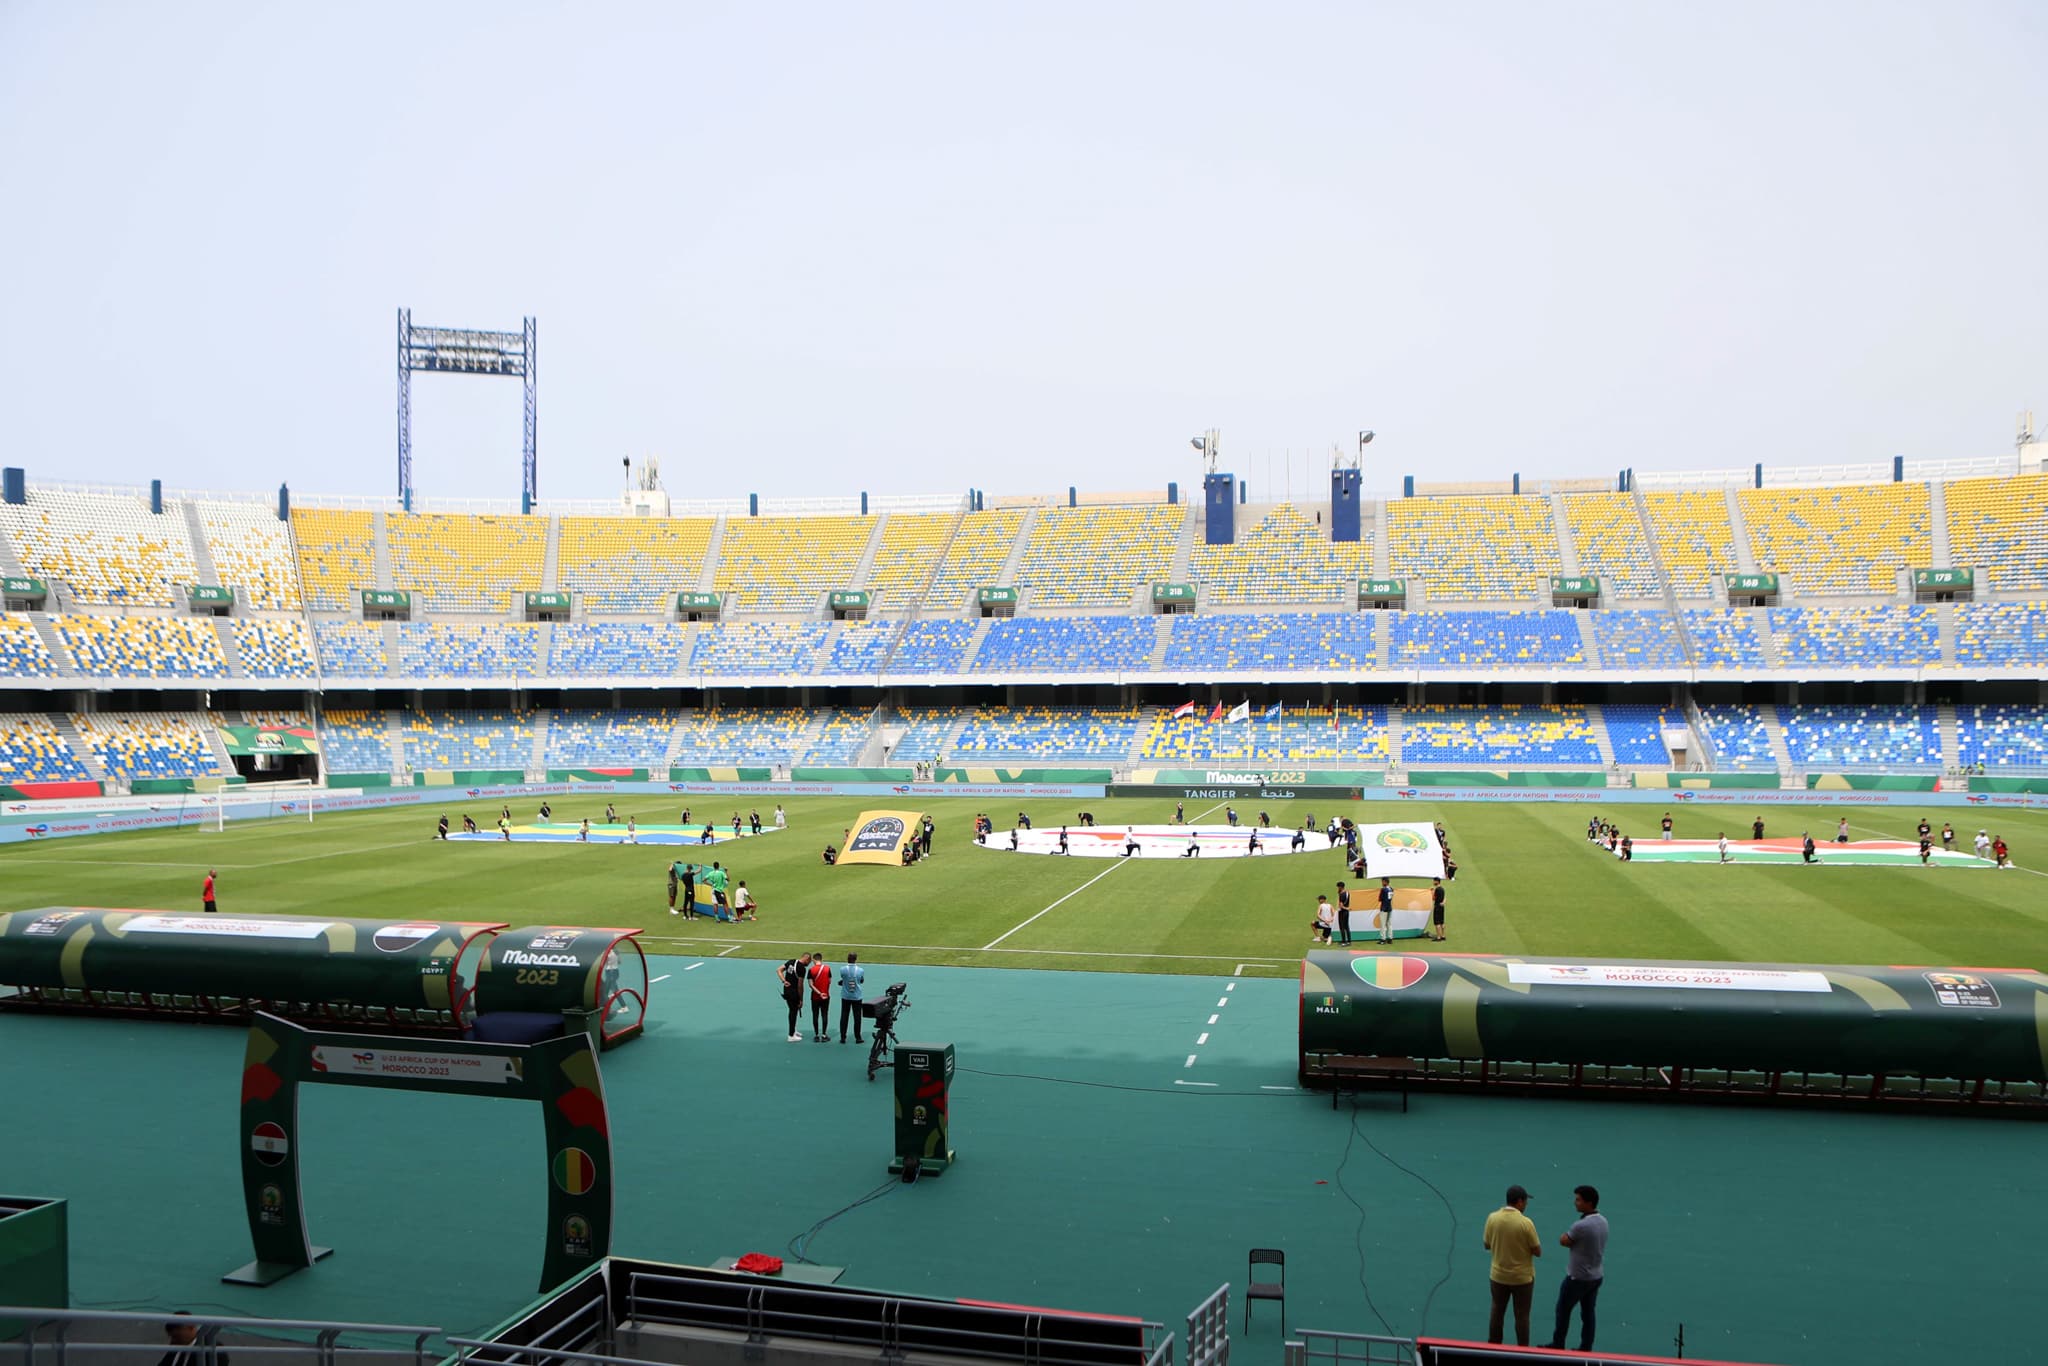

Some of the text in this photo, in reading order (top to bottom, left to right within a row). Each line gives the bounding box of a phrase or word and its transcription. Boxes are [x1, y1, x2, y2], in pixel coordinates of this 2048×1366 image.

[1935, 573, 1952, 582] 17B
[1372, 584, 1390, 593] 20B
[1566, 581, 1581, 590] 19B
[1271, 771, 1306, 783] 2023
[1184, 790, 1236, 798] TANGIER
[1260, 789, 1295, 800] طنجة
[516, 969, 559, 985] 2023
[1605, 974, 1731, 984] MOROCCO 2023
[1316, 1006, 1339, 1014] MALI
[450, 1058, 481, 1067] NATIONS
[382, 1063, 426, 1074] MOROCCO
[428, 1067, 449, 1076] 2023
